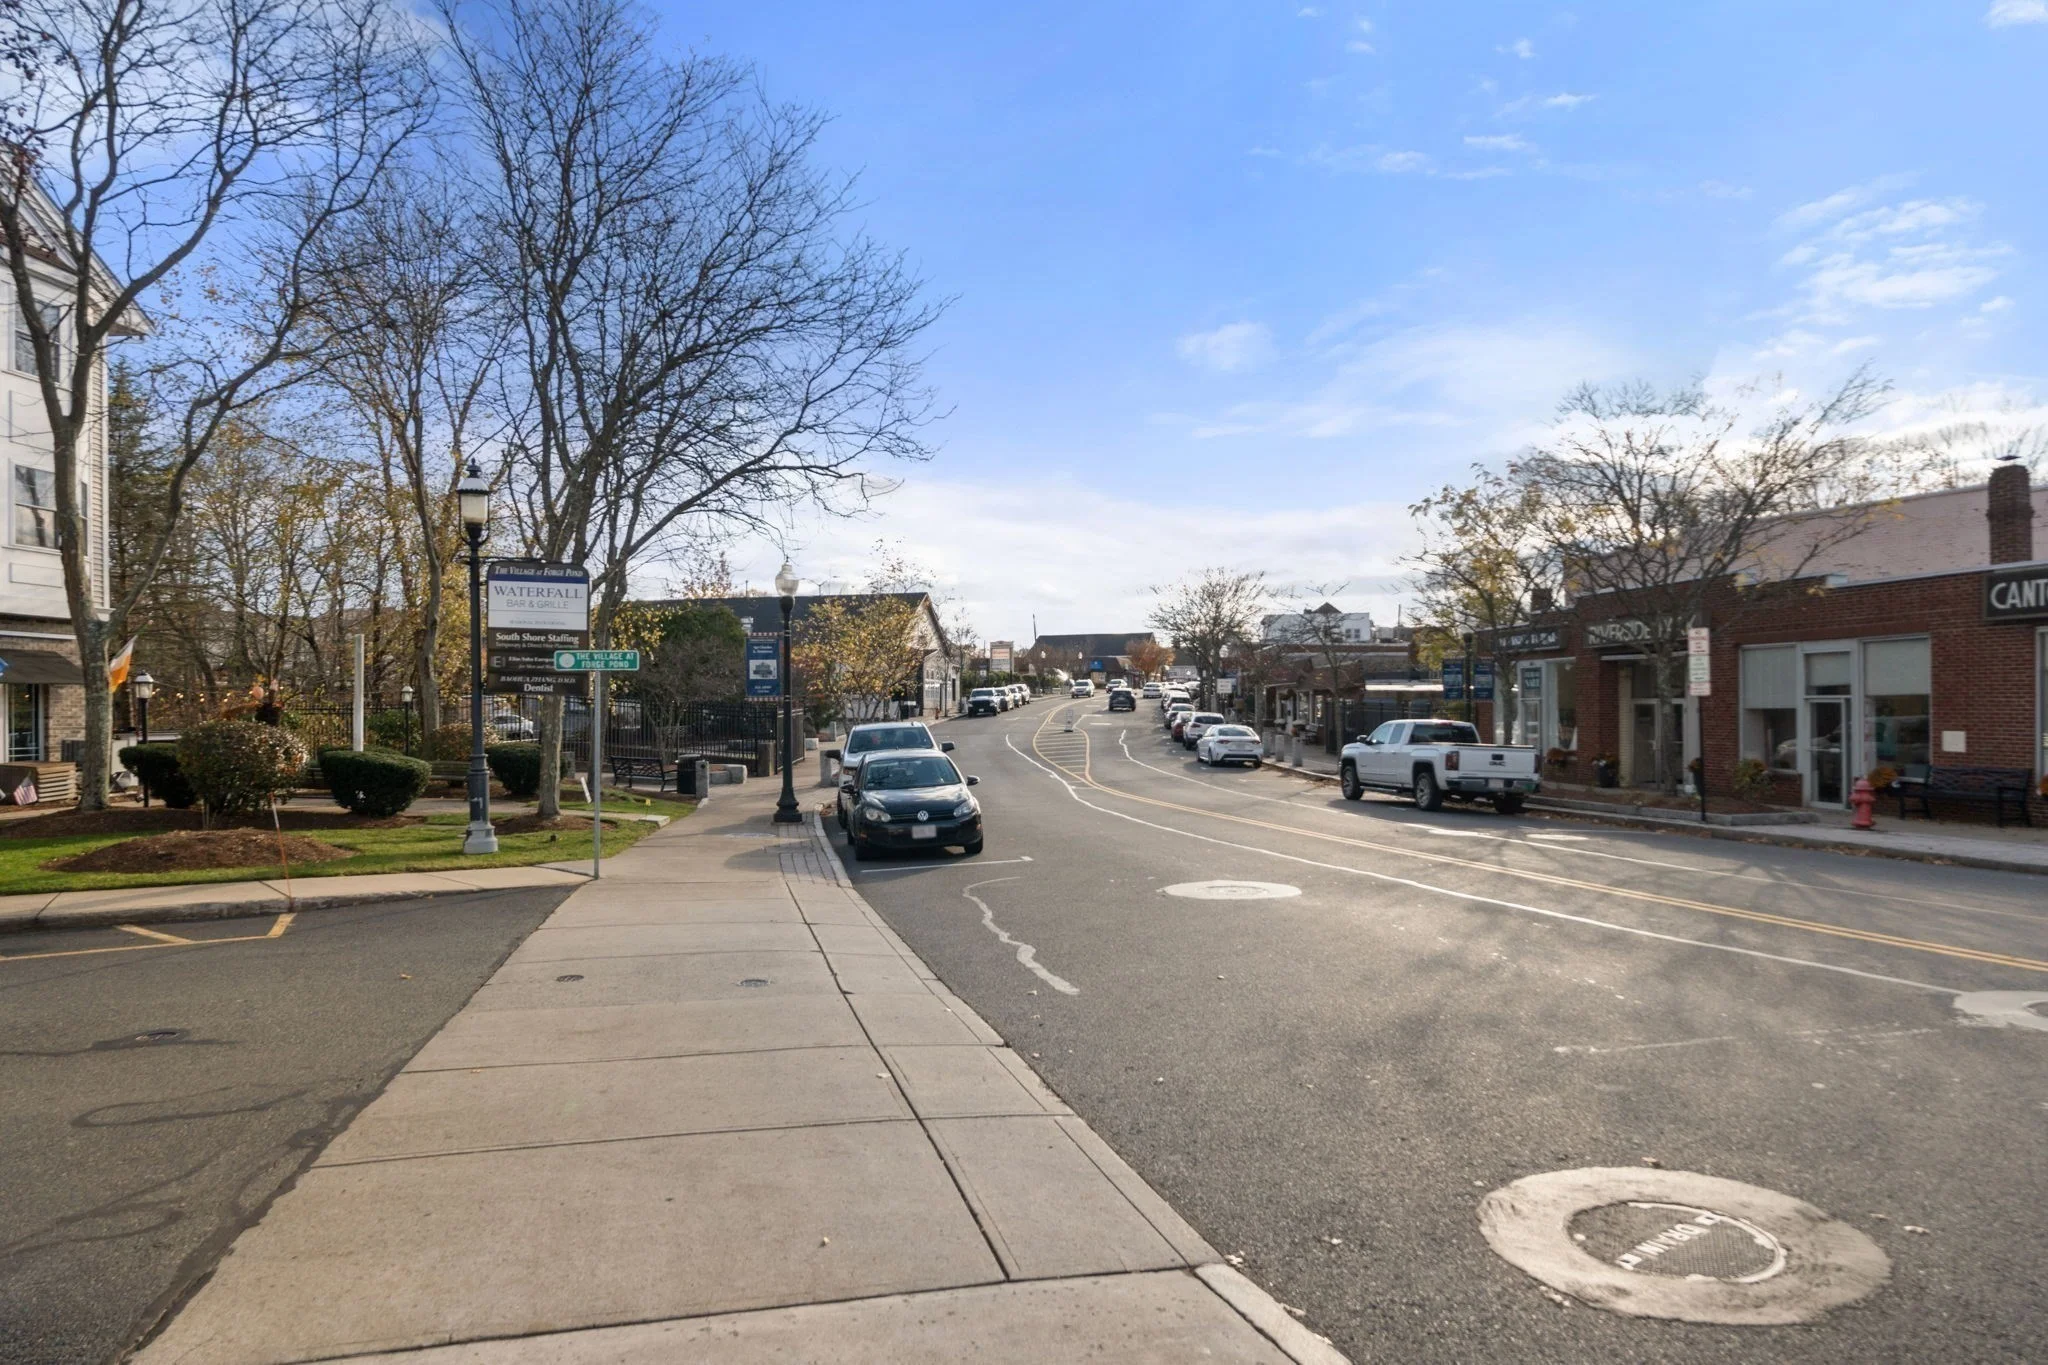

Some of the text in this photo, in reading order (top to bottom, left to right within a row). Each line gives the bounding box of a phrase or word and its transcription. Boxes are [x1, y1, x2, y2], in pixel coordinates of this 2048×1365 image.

[509, 566, 535, 576] VILLAGE
[543, 567, 564, 577] FORGE
[565, 568, 584, 577] POND
[494, 585, 584, 599] WATERFALL
[1990, 579, 2048, 609] CANT
[506, 599, 569, 610] BAR & GRILLE
[496, 632, 579, 645] South Shore Staffing
[577, 653, 634, 661] THE VILLAGE AT
[582, 660, 630, 669] FORGE POND
[524, 683, 554, 692] Dentist
